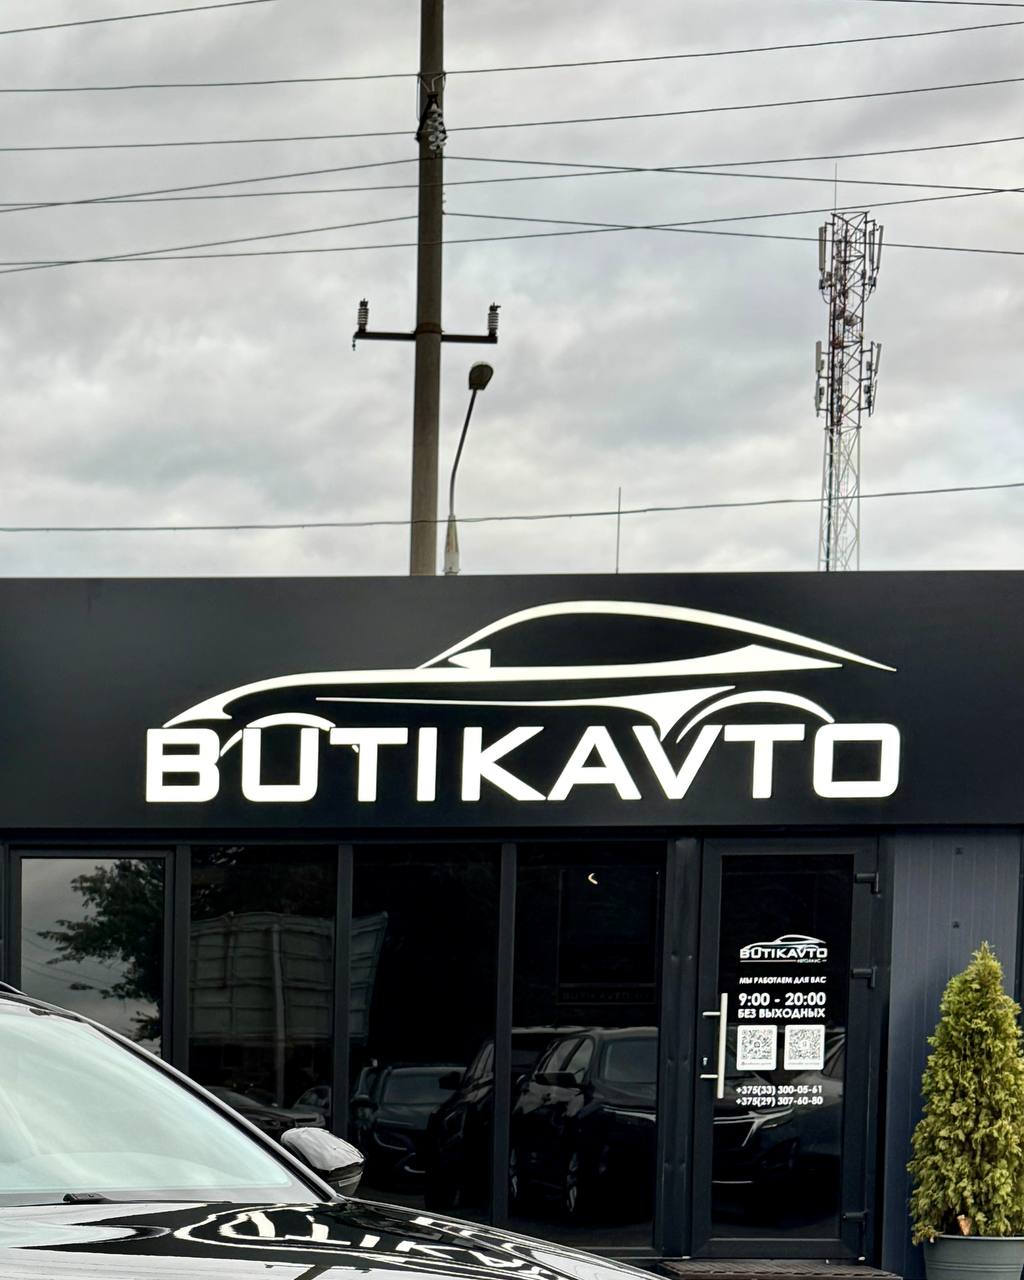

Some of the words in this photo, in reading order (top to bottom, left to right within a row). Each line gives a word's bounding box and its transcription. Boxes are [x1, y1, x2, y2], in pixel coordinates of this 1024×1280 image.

[145, 721, 902, 804] BUTIKAVTO
[739, 947, 828, 959] BUTIKAVTO
[754, 976, 793, 984] РАБОТАЕМ
[794, 976, 810, 984] ДЛЯ
[738, 993, 770, 1006] 9:00
[784, 992, 826, 1006] 20:00
[738, 1009, 756, 1018] БЕЗ
[759, 1008, 826, 1019] ВЫХОДНЫХ
[736, 1086, 776, 1096] +375(33)
[777, 1085, 822, 1094] 300-05-61
[736, 1097, 776, 1107] +375(29)
[777, 1096, 823, 1106] 307-60-80
